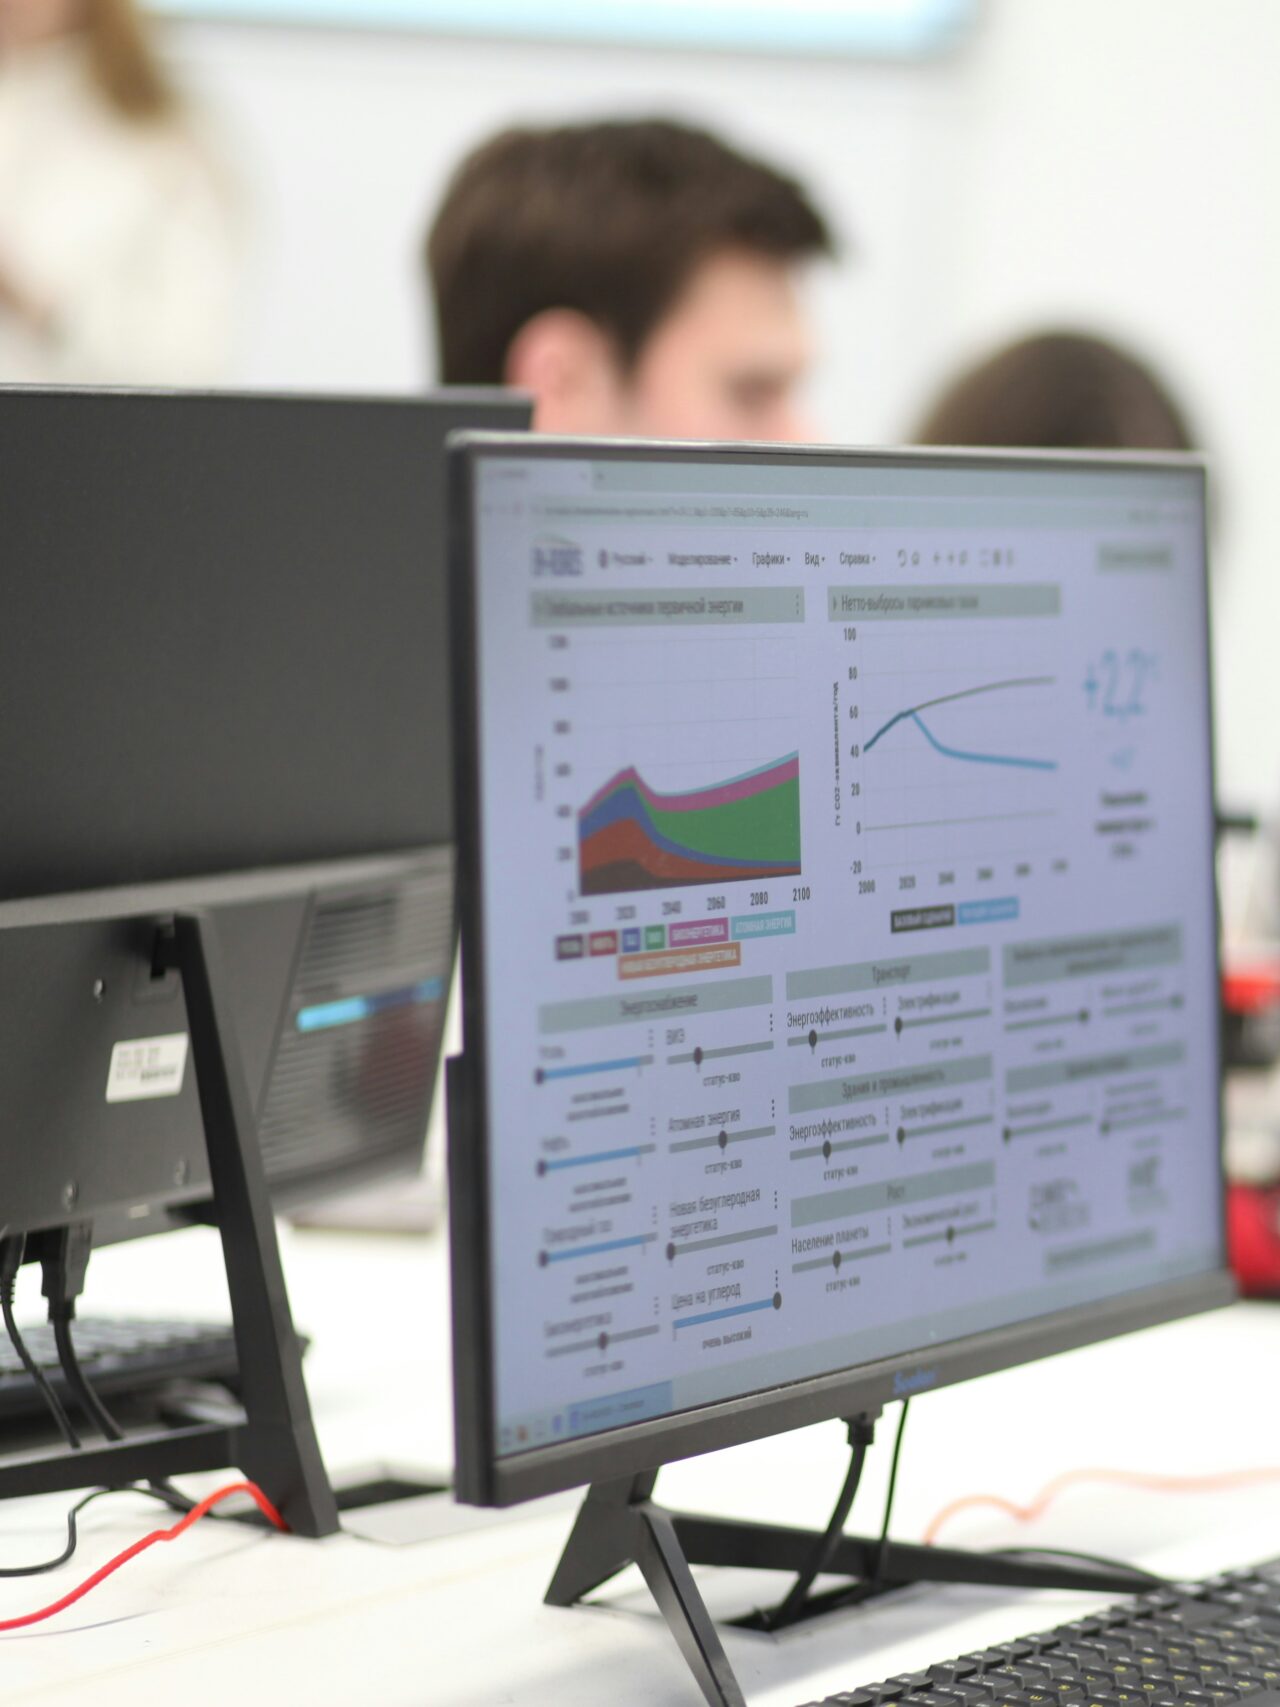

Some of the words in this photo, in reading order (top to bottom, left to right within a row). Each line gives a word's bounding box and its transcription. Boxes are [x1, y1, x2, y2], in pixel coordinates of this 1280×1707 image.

[752, 551, 785, 568] Графики
[804, 551, 820, 568] Вид
[840, 552, 871, 568] Справка
[844, 627, 857, 642] 100
[849, 666, 858, 681] 80
[849, 706, 858, 720] 60
[850, 744, 860, 758] 40
[851, 783, 860, 796] 20
[856, 821, 861, 835] 0
[850, 860, 862, 874] -20
[792, 886, 811, 902] 2100
[858, 879, 876, 895] 2000
[706, 895, 726, 911] 2060
[750, 891, 769, 907] 2080
[787, 1003, 874, 1029] Энергоэффективность
[821, 1053, 857, 1069] статус-кво
[703, 1072, 741, 1088] статус-кво
[707, 1108, 741, 1128] энергия
[789, 1113, 877, 1143] Энергоэффективность
[705, 1159, 743, 1175] статус-кво
[823, 1165, 859, 1182] статус-кво
[699, 1188, 761, 1215] безуглеродная
[792, 1233, 835, 1254] Население
[835, 1226, 870, 1247] планеты
[707, 1259, 745, 1276] статус-кво
[672, 1293, 694, 1312] Цена
[698, 1291, 706, 1303] на
[707, 1283, 741, 1303] углерод
[702, 1337, 722, 1350] очень
